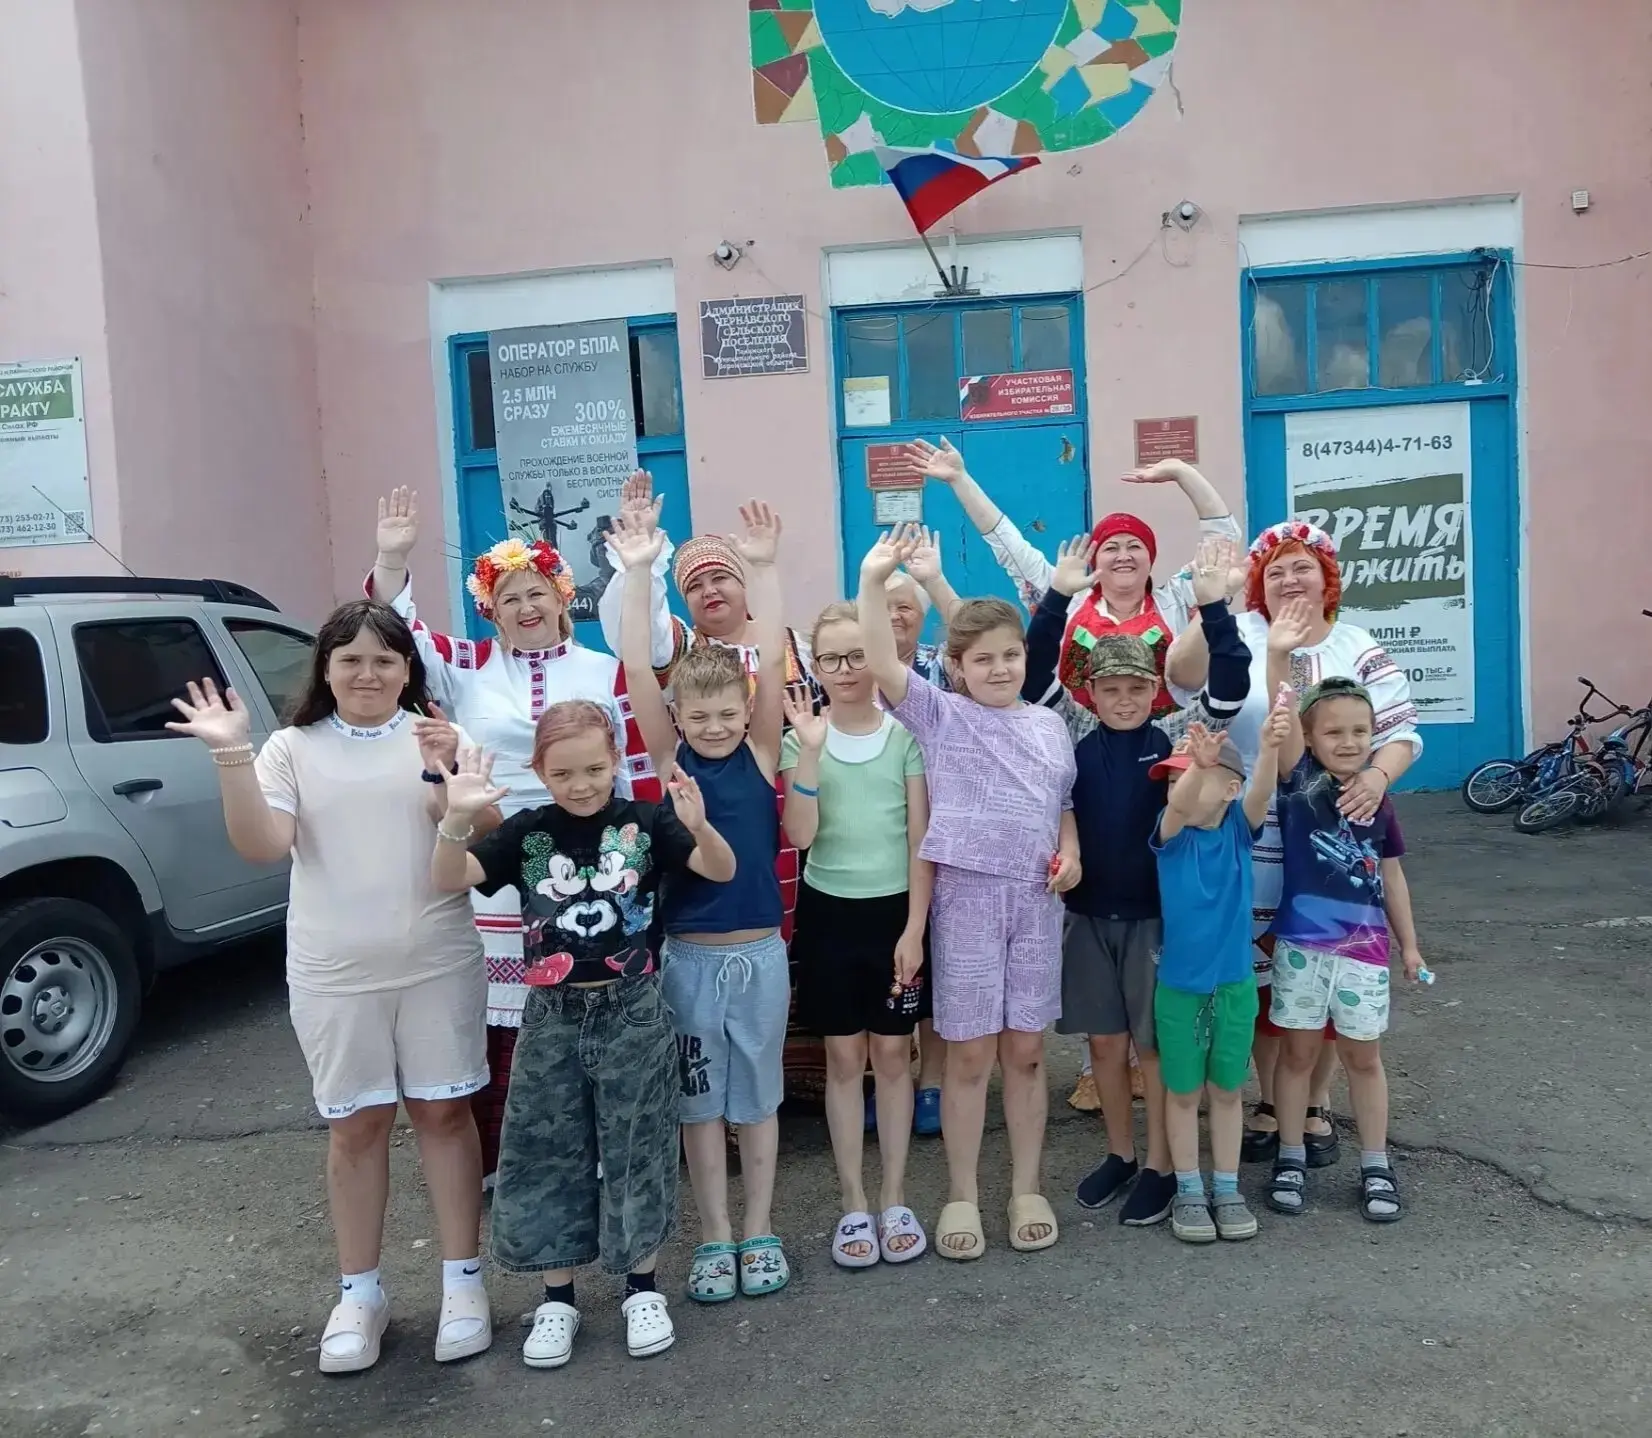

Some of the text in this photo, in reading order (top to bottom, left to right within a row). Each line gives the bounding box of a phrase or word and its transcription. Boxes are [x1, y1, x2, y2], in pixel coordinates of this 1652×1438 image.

[714, 313, 791, 326] ЧЕРНАВСКОГО
[723, 324, 784, 336] СЕЛЬСКОГО
[722, 334, 786, 347] ПОСЕЛЕНИЯ
[499, 335, 620, 362] ОПЕРАТОР БПЛА
[500, 360, 598, 379] НАБОР НА СЛУЖБУ
[1005, 375, 1062, 387] УЧАСТКОВАЯ
[0, 379, 66, 398] СЛУЖБА
[502, 385, 557, 404] 2.5 МЛН
[998, 383, 1072, 396] ИЗБИРАТЕЛЬНАЯ
[1011, 394, 1059, 405] КОМИССИЯ
[1, 400, 51, 419] РАКТУ
[503, 403, 550, 421] СРАЗУ
[574, 399, 626, 422] 300%
[26, 420, 39, 429] РФ
[551, 421, 627, 437] ЕЖЕМЕСЯЧНЫЕ
[541, 432, 627, 449] СТАВКИ К ОКЛАДУ
[1302, 435, 1453, 460] 8(47344)4-71-63
[520, 450, 629, 468] ПРОХОЖДЕНИЕ ВОЕННОЙ
[509, 463, 630, 481] СЛУЖБЫ ТОЛЬКО В ВОЙСКАХ
[597, 488, 623, 499] СИСТ
[15, 512, 55, 522] 253-02-71
[0, 522, 56, 534] 73) 462-12-30
[1337, 546, 1466, 592] ужить
[1369, 627, 1405, 639] МЛН
[1376, 638, 1448, 647] ИНОВРЕМЕННАЯ
[1385, 645, 1456, 654] ЕЖНАЯ ВЫПЛАТА
[1404, 668, 1424, 682] 10
